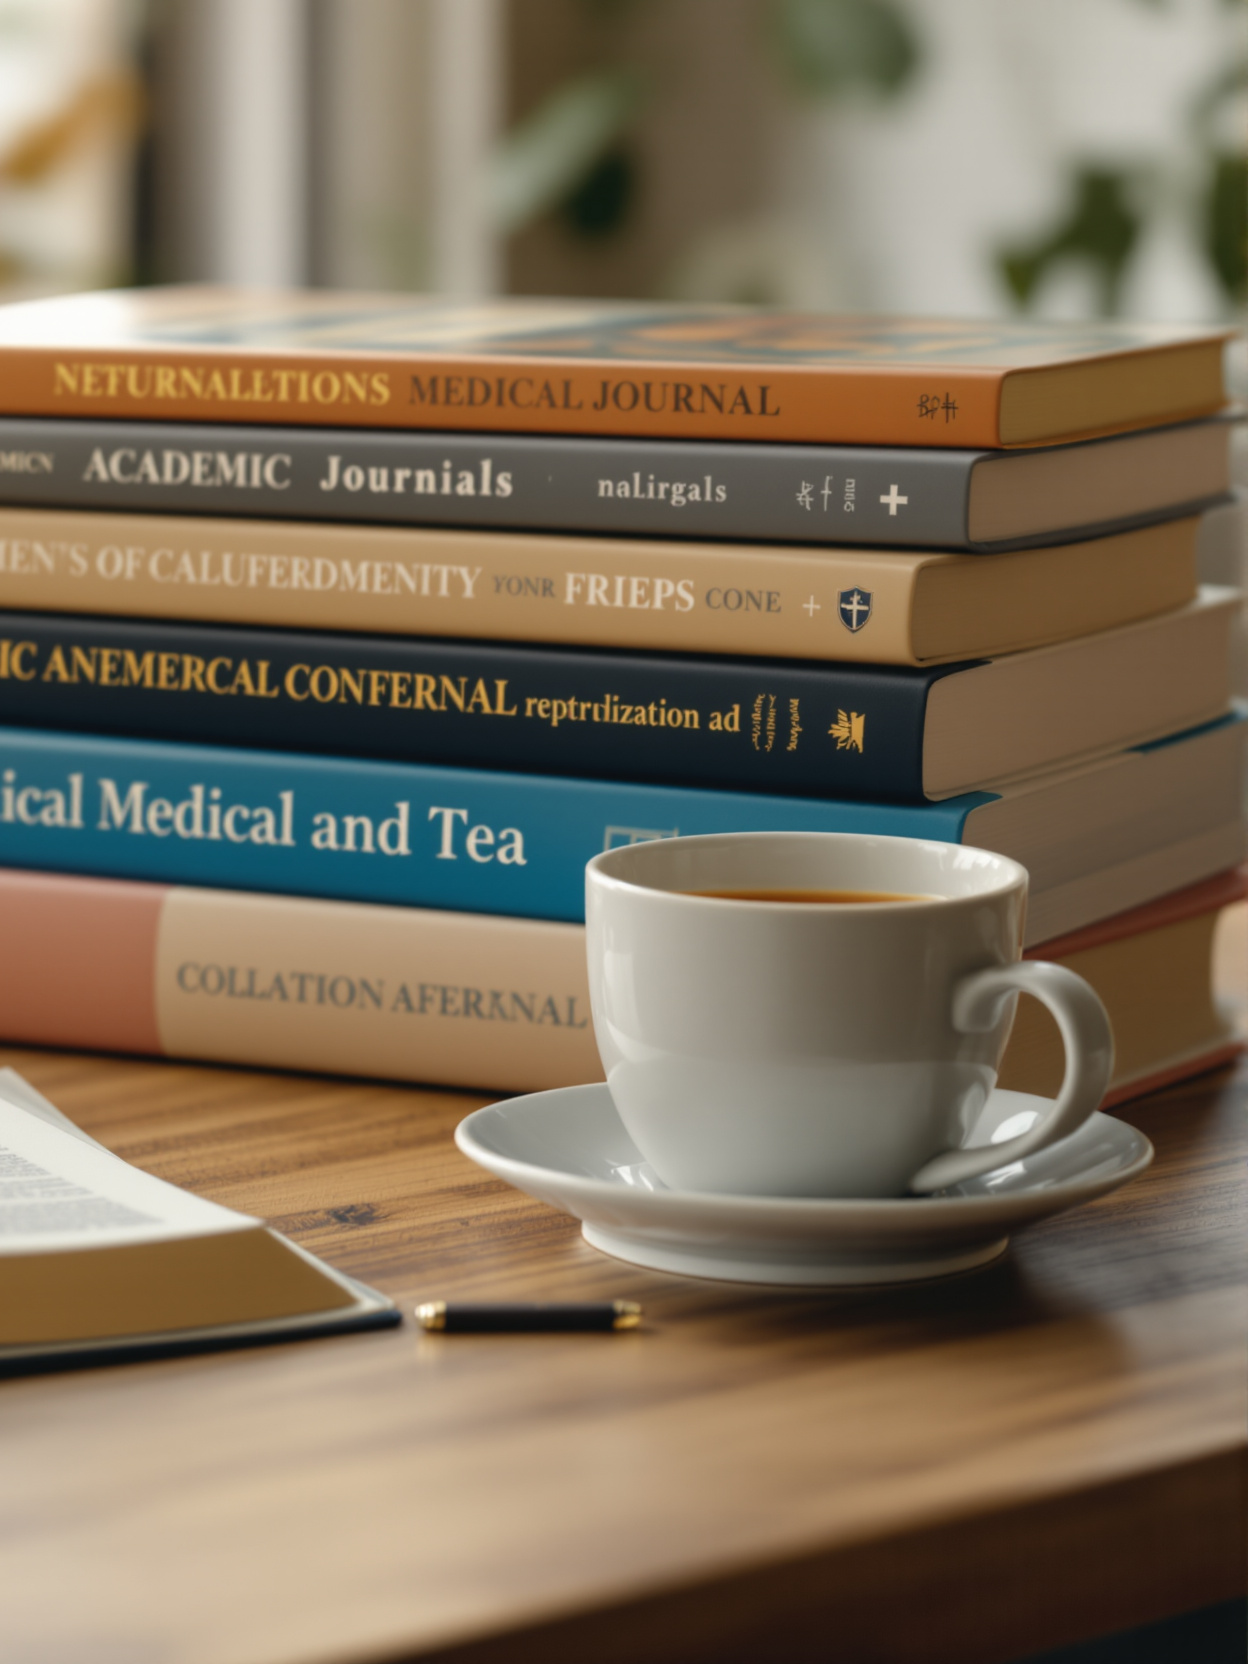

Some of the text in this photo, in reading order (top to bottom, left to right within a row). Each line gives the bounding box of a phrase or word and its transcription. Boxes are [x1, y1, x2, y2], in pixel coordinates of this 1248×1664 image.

[408, 374, 584, 412] MEDICAL
[593, 380, 781, 417] JOURNAL
[84, 447, 292, 490] ACADEMIC
[320, 455, 513, 498] Journials
[95, 544, 145, 580] OF
[564, 571, 696, 612] FRIEPS
[704, 587, 783, 614] CONE
[41, 643, 280, 700] ANEMERCAL
[284, 662, 518, 717] CONFERNAL
[708, 704, 742, 733] ad
[96, 778, 297, 848] Medical
[310, 801, 413, 857] and
[427, 806, 528, 867] Tea
[176, 961, 386, 1010] COLLATION
